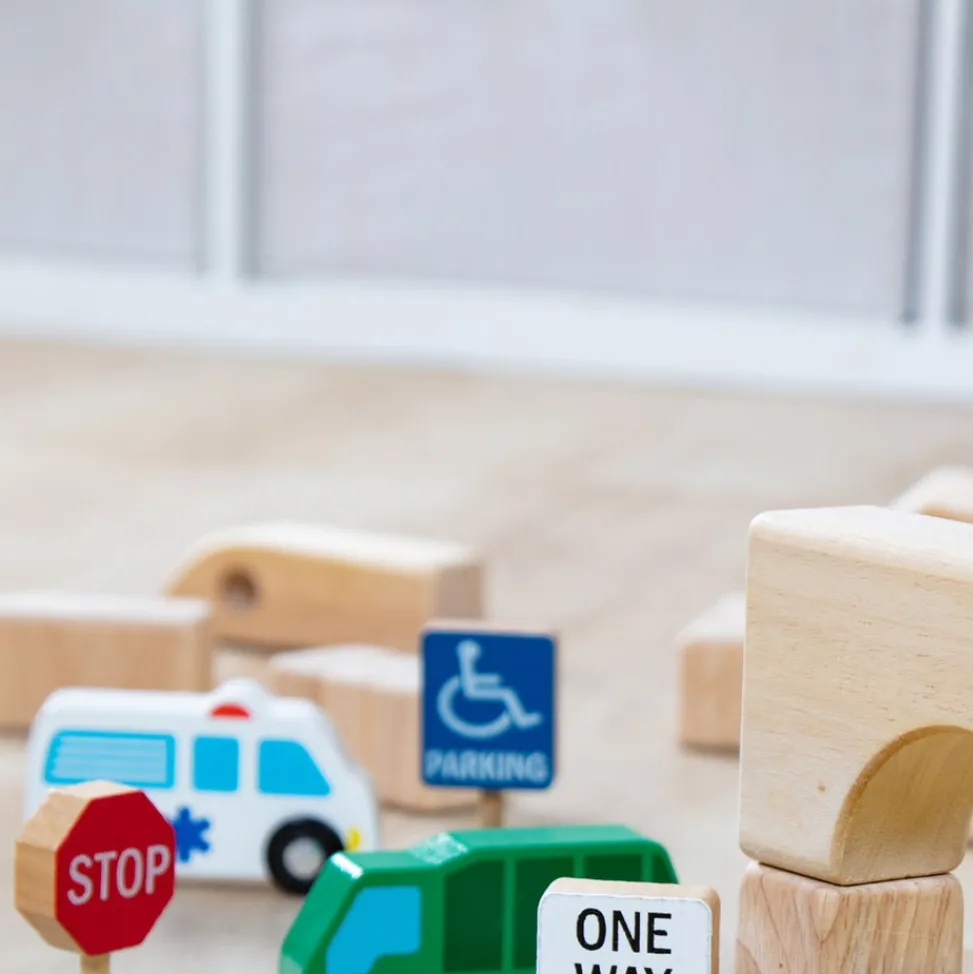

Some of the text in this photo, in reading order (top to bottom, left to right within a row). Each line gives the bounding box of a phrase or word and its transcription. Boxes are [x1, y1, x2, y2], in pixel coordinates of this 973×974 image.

[424, 749, 549, 784] PARKING
[67, 843, 171, 905] STOP
[576, 908, 672, 955] ONE
